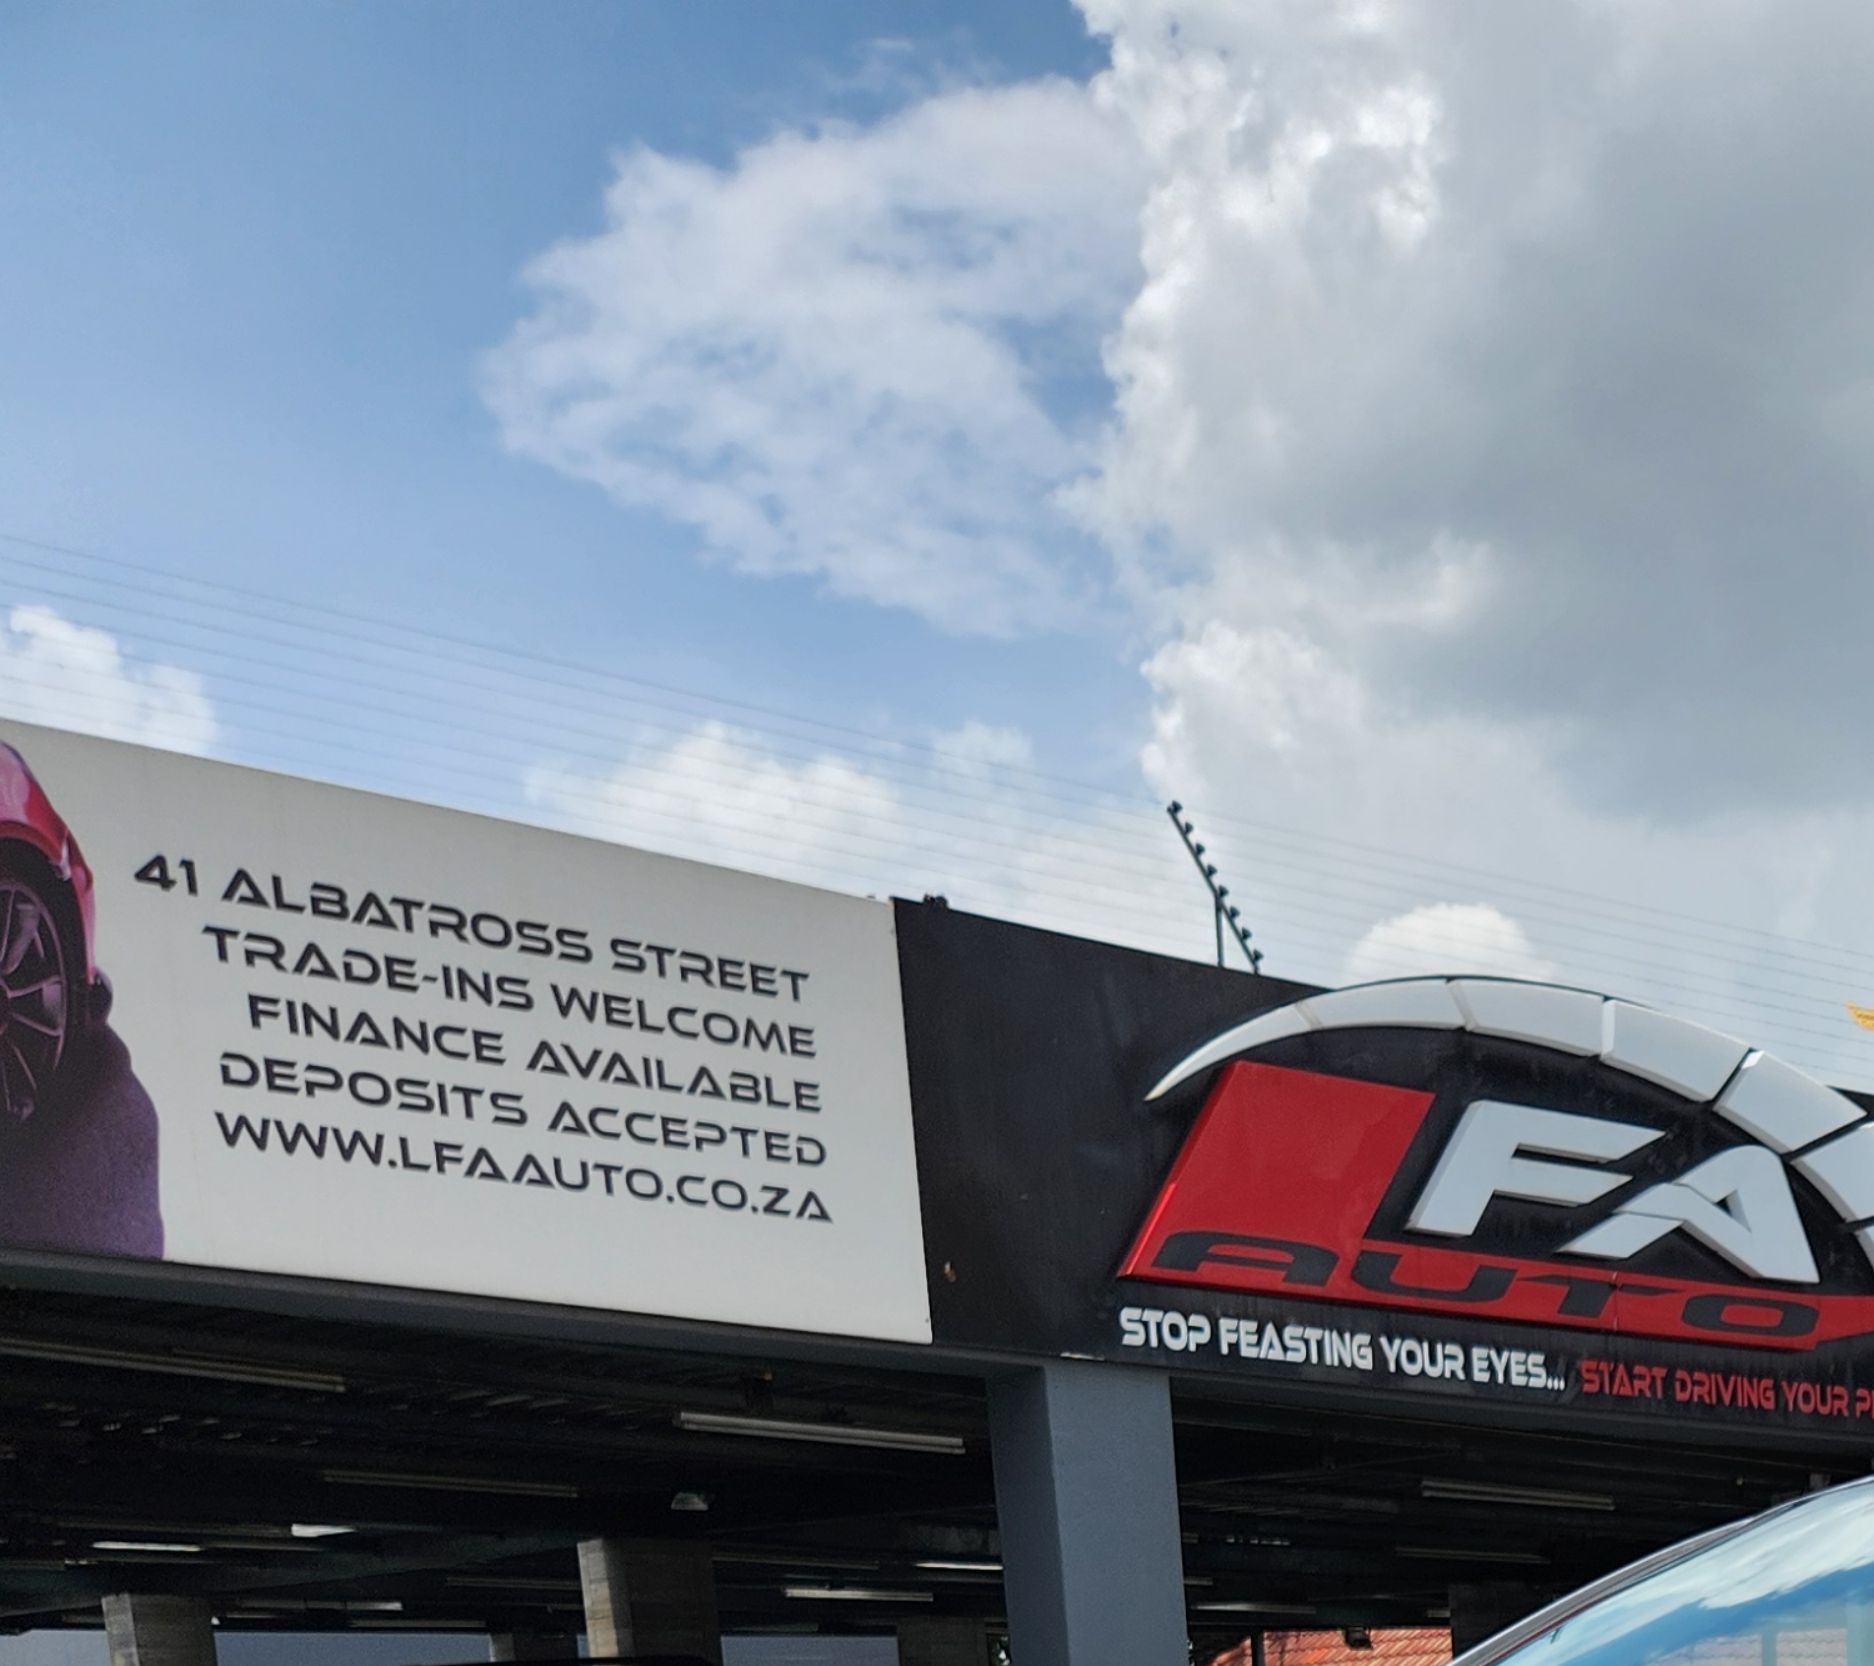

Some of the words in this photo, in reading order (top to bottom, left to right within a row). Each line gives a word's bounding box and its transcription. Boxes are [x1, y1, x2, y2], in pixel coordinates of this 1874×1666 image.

[134, 855, 198, 896] 41
[221, 868, 593, 964] ALBATROSS
[609, 938, 810, 1002] STREET
[202, 925, 534, 1011] TRADE-INS
[550, 983, 816, 1058] WELCOME
[220, 1051, 528, 1126] DEPOSITS
[548, 1101, 826, 1166] ACCEPTED
[247, 993, 506, 1086] FINANCE
[526, 1040, 821, 1113] AVAILABLE
[214, 1111, 832, 1222] WWW.LFAAUTO.CO.ZA
[1151, 1230, 1819, 1338] AUTO
[1120, 1307, 1211, 1352] STOP
[1219, 1317, 1373, 1370] FEASTING
[1379, 1336, 1465, 1383] YOUR
[1471, 1347, 1566, 1392] EYES...
[1580, 1359, 1669, 1399] START
[1674, 1370, 1776, 1412] DRIVING
[1780, 1380, 1850, 1416] YOUR
